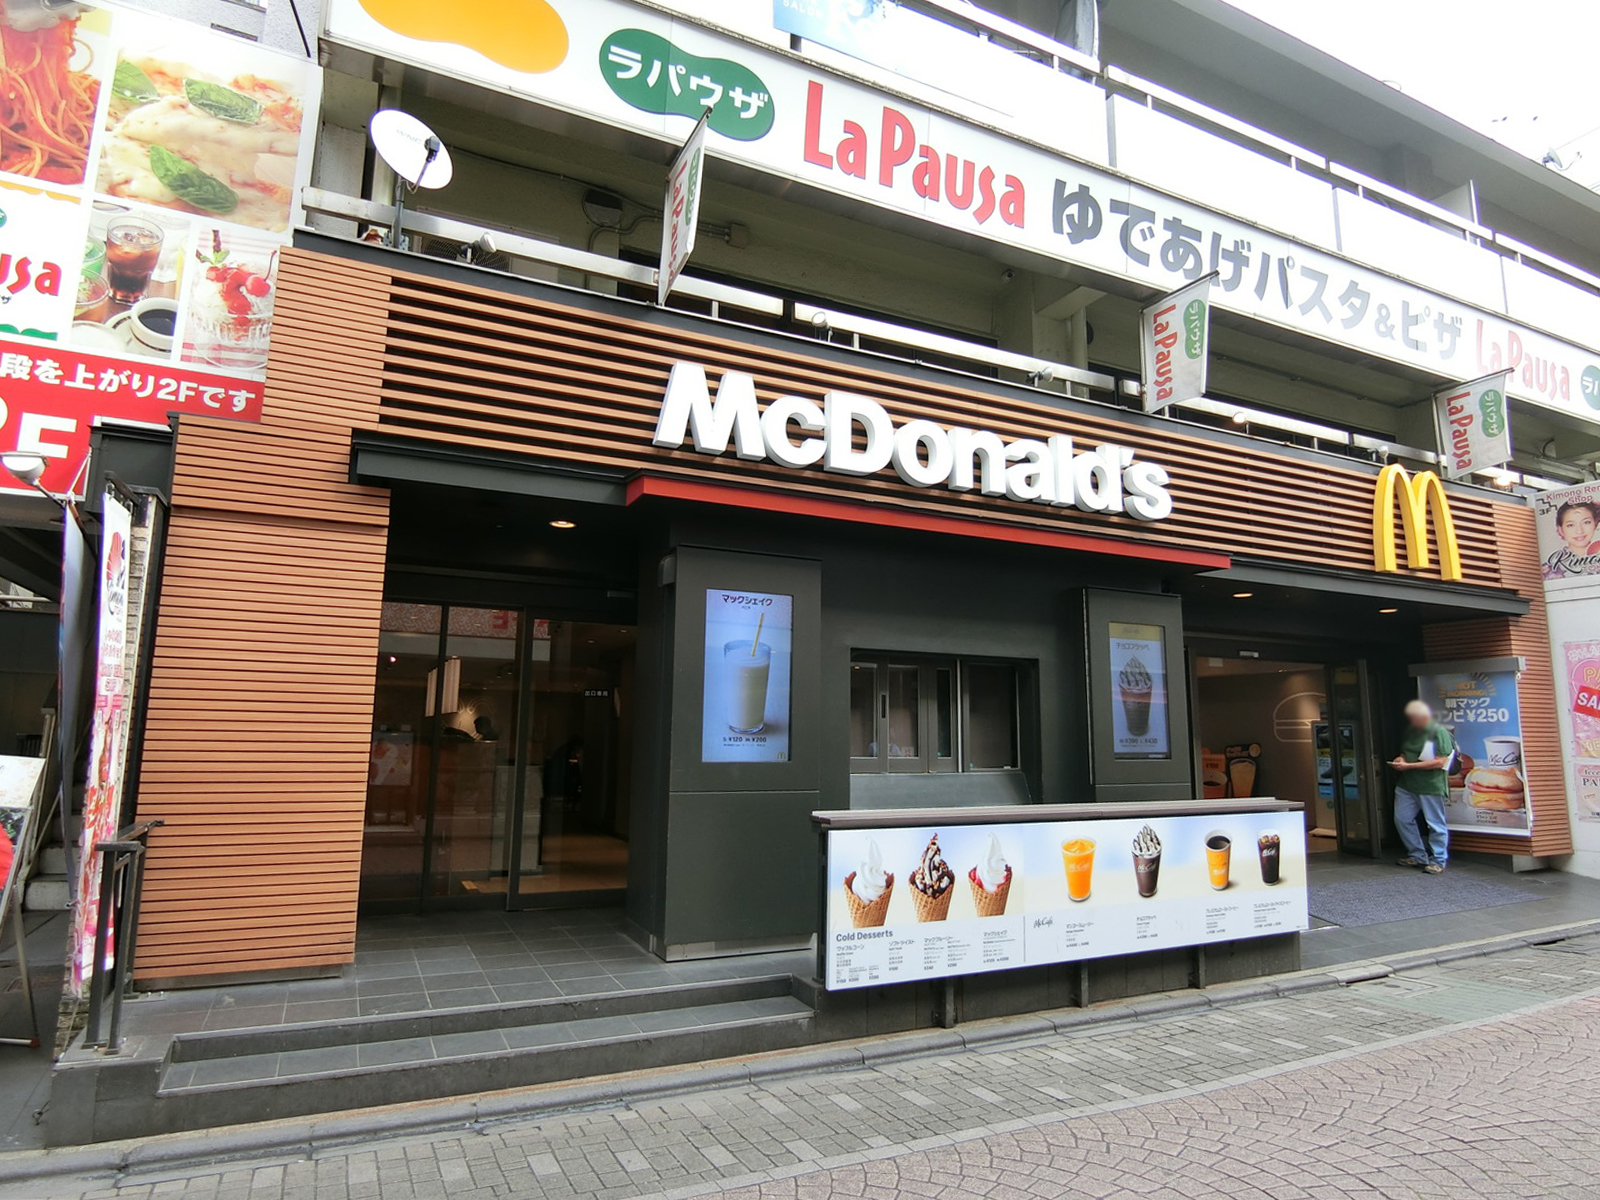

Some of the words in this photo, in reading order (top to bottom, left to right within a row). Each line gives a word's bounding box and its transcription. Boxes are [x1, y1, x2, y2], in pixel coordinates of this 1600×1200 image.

[608, 44, 769, 120] ラパウザ
[804, 80, 867, 179] La
[879, 106, 1026, 229] Pausa
[651, 360, 1172, 521] McDonald's
[1545, 489, 1582, 501] Kimono
[1568, 494, 1593, 505] Shop
[721, 594, 773, 607] マックシェイク
[1577, 691, 1600, 710] SA
[836, 932, 855, 942] Cold
[857, 930, 893, 941] Desserts
